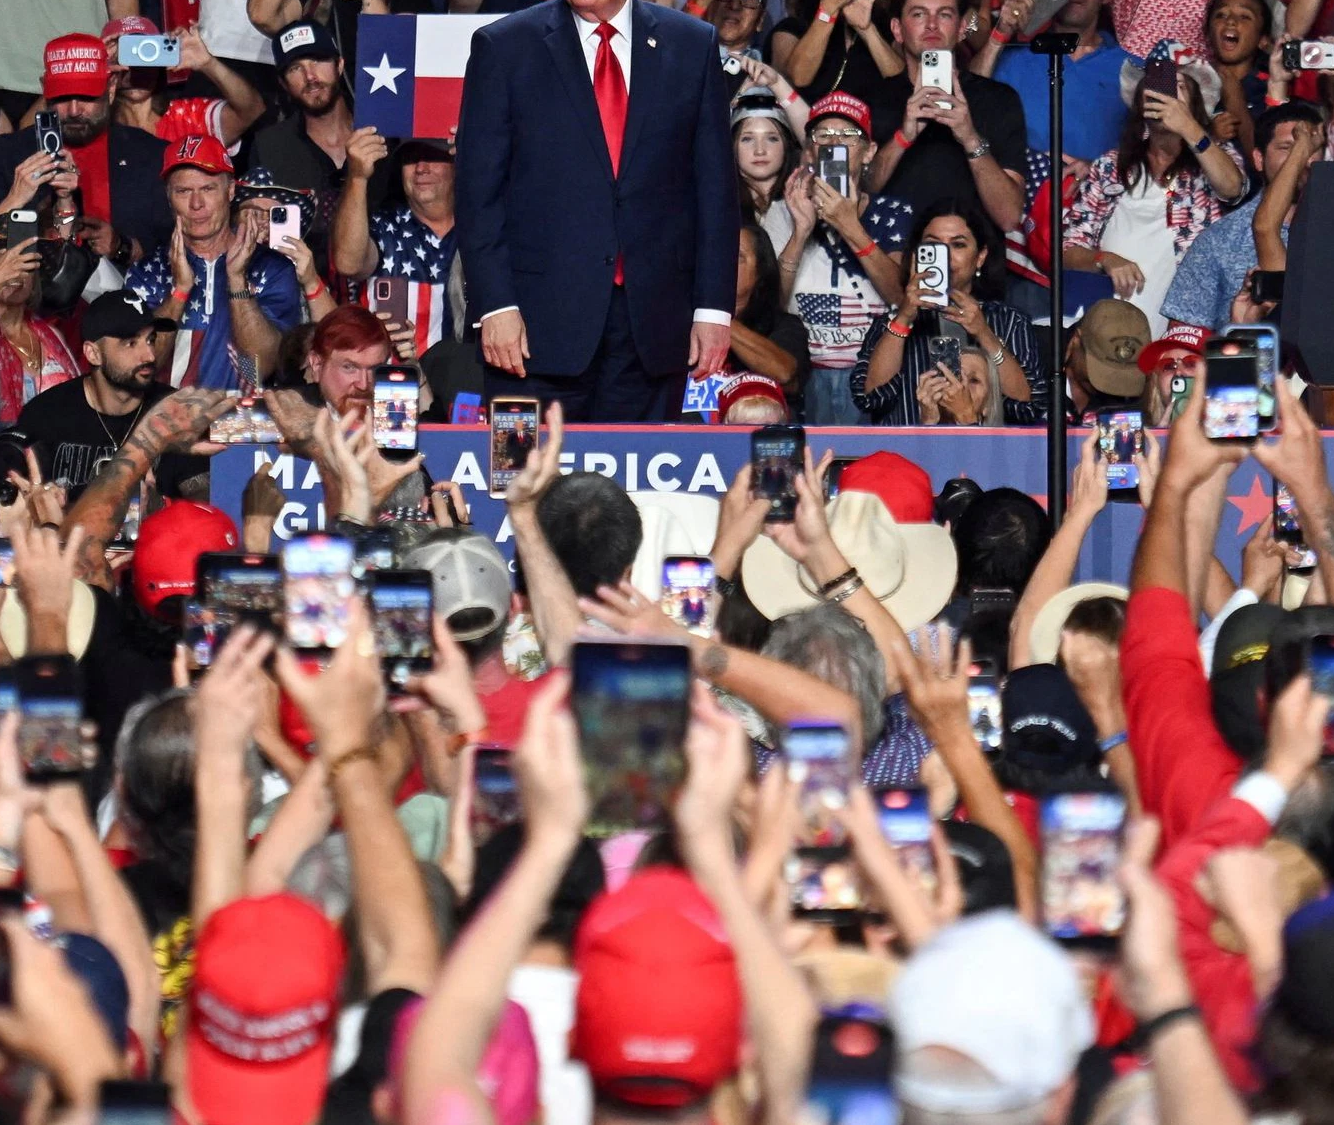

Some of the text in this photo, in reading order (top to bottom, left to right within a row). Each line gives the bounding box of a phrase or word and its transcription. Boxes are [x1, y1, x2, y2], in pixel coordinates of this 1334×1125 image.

[46, 47, 101, 63] MAKE AMERICA
[51, 62, 97, 76] GREAT AGAIN
[176, 135, 204, 161] 47
[741, 374, 777, 390] AMERICA
[450, 451, 730, 492] AERICA
